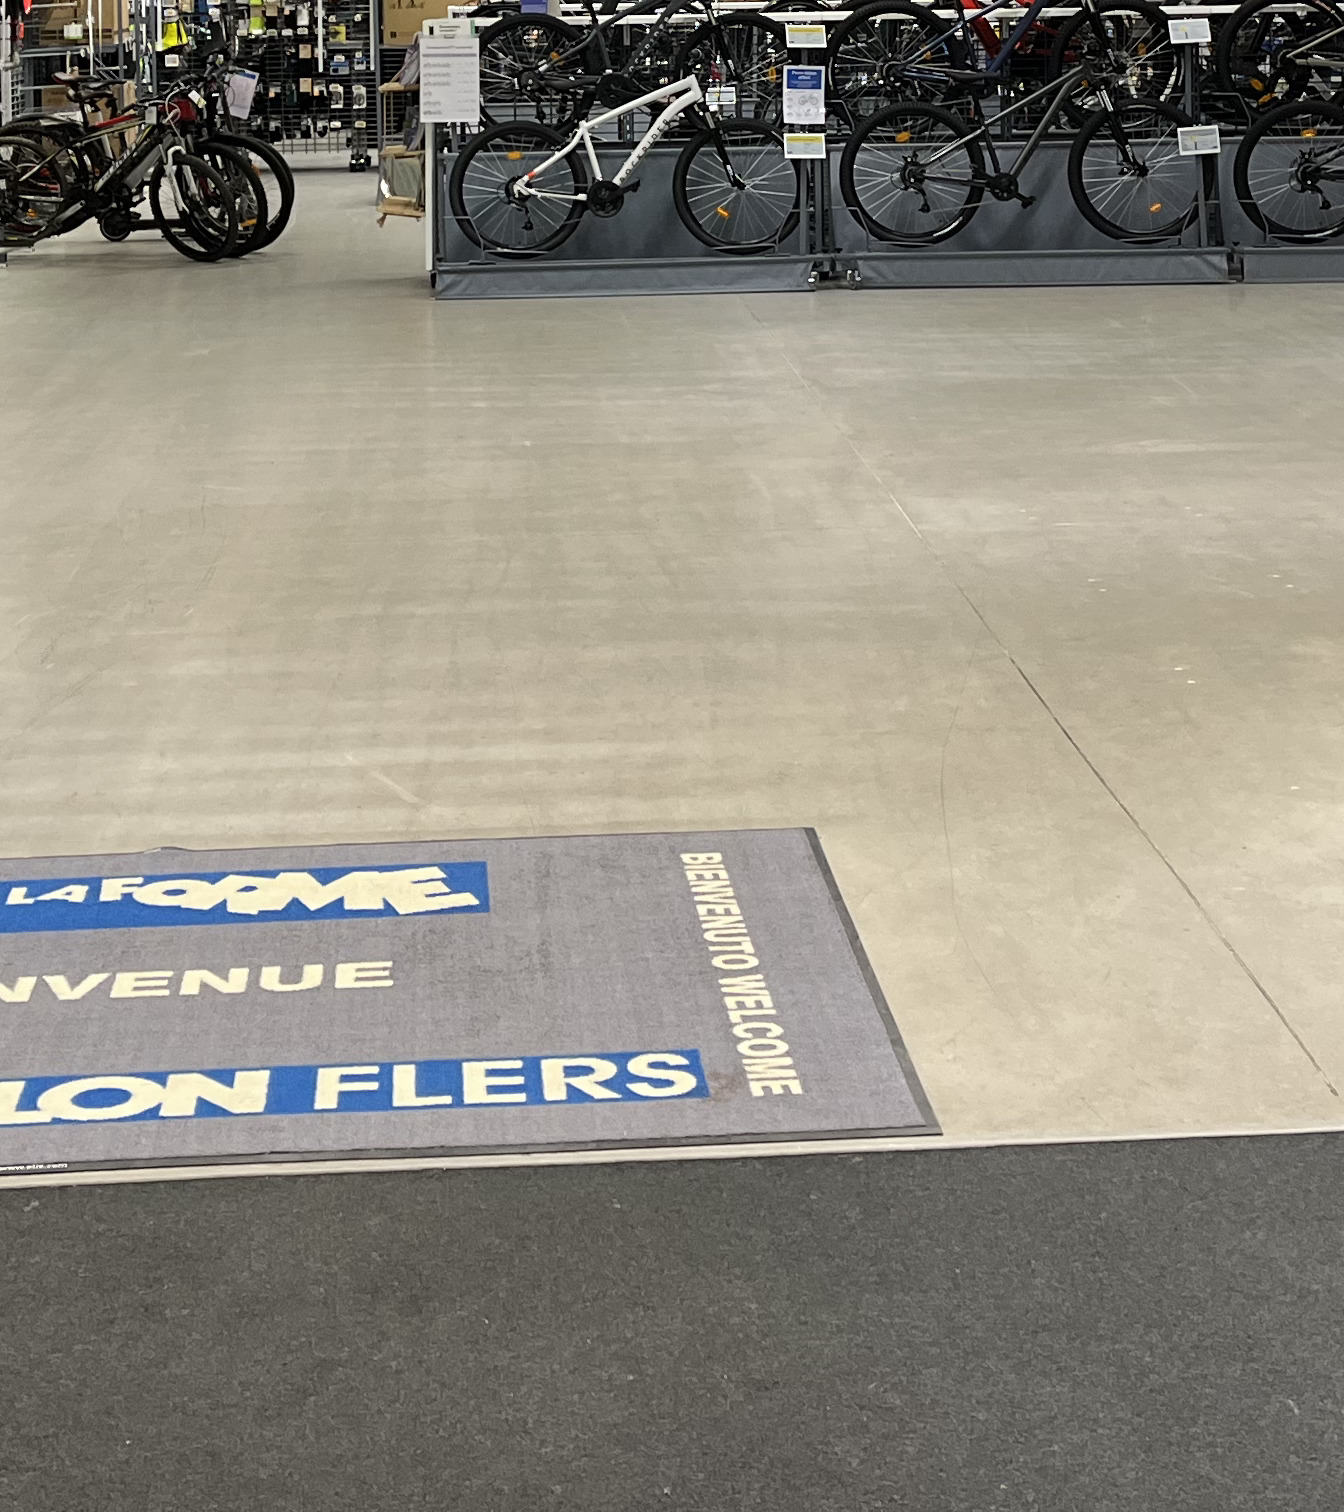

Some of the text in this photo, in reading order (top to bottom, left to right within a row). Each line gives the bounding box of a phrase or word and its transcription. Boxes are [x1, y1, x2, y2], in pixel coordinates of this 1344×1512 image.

[4, 883, 88, 907] LA
[679, 851, 760, 971] BIENVENUTO
[716, 973, 804, 1098] WELCOME
[312, 1052, 698, 1111] FLERS
